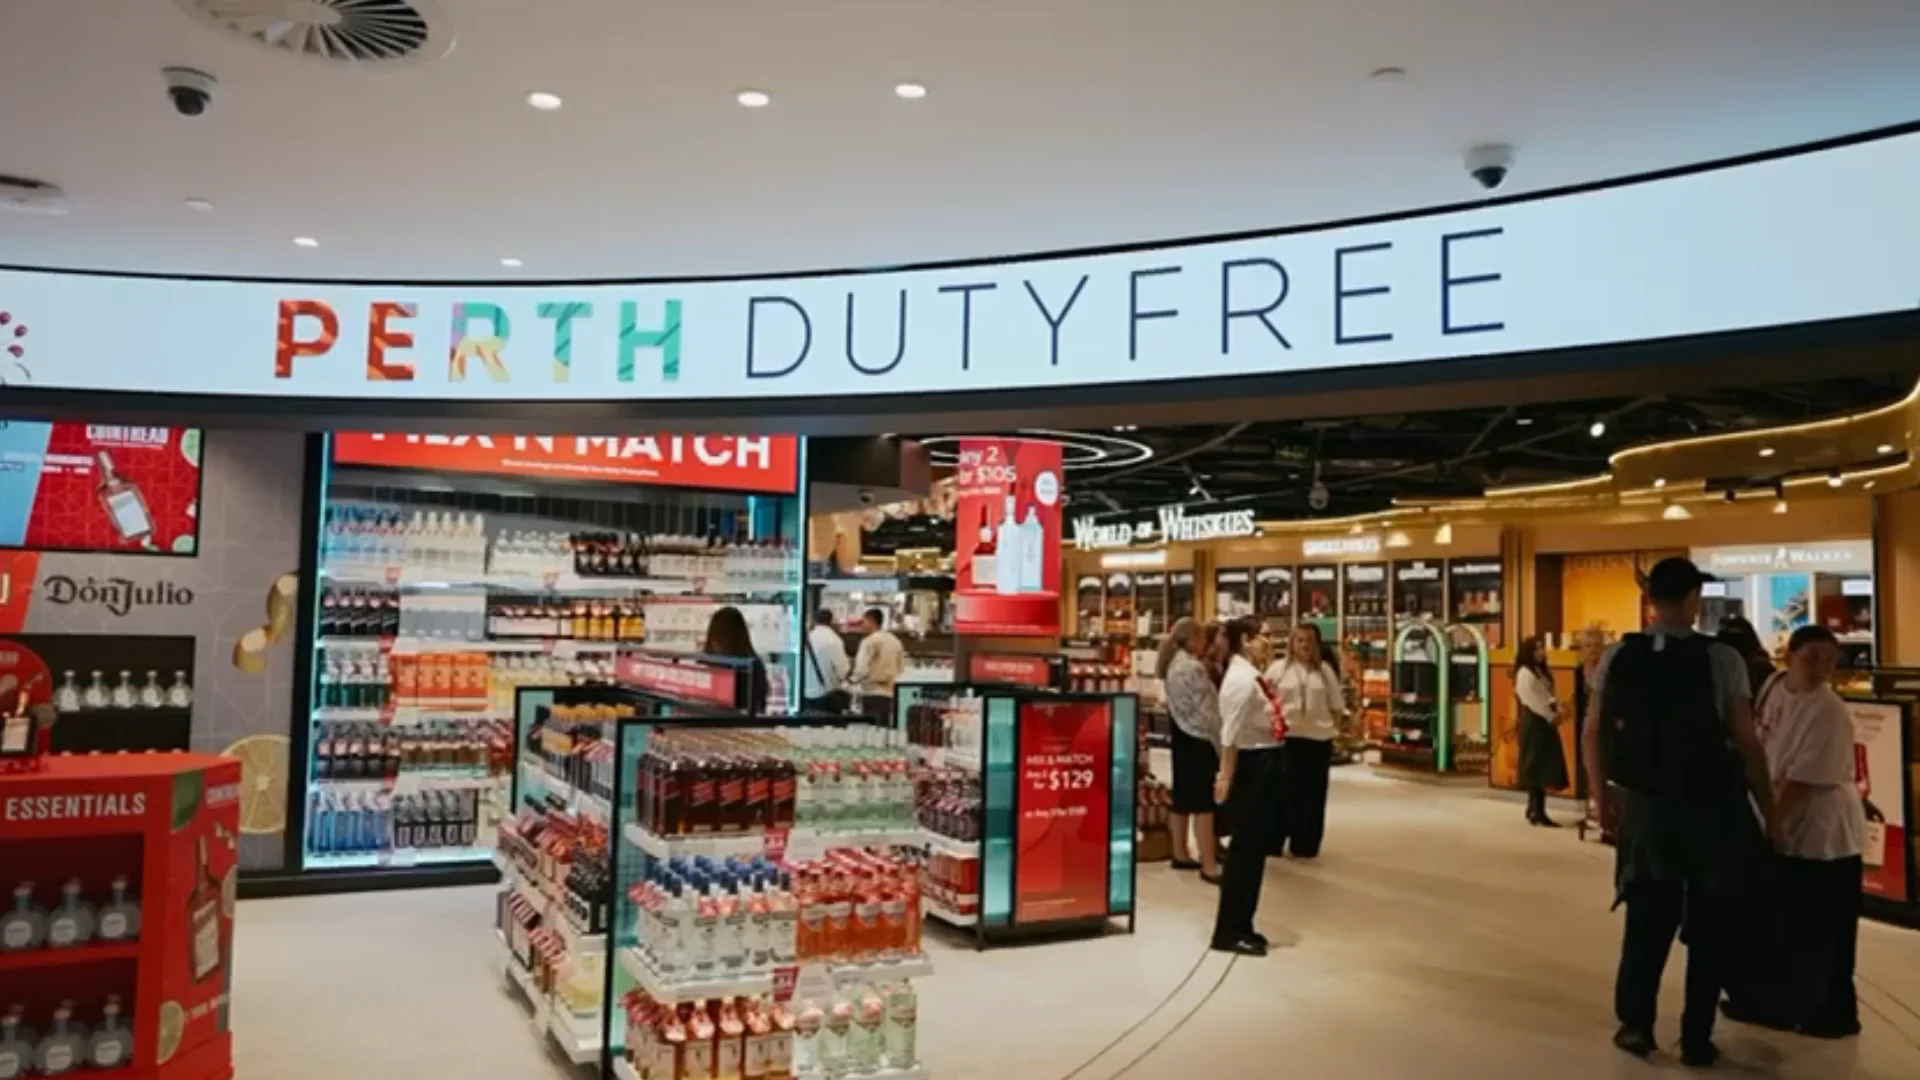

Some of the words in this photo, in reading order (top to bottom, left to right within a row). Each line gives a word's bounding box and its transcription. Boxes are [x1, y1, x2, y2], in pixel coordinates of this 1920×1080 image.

[275, 298, 683, 383] PERTH
[745, 227, 1505, 380] DUTYFREE
[987, 446, 999, 462] 2
[1056, 753, 1094, 764] MATCH
[1049, 767, 1094, 791] $129
[5, 793, 146, 820] ESSENTIALS
